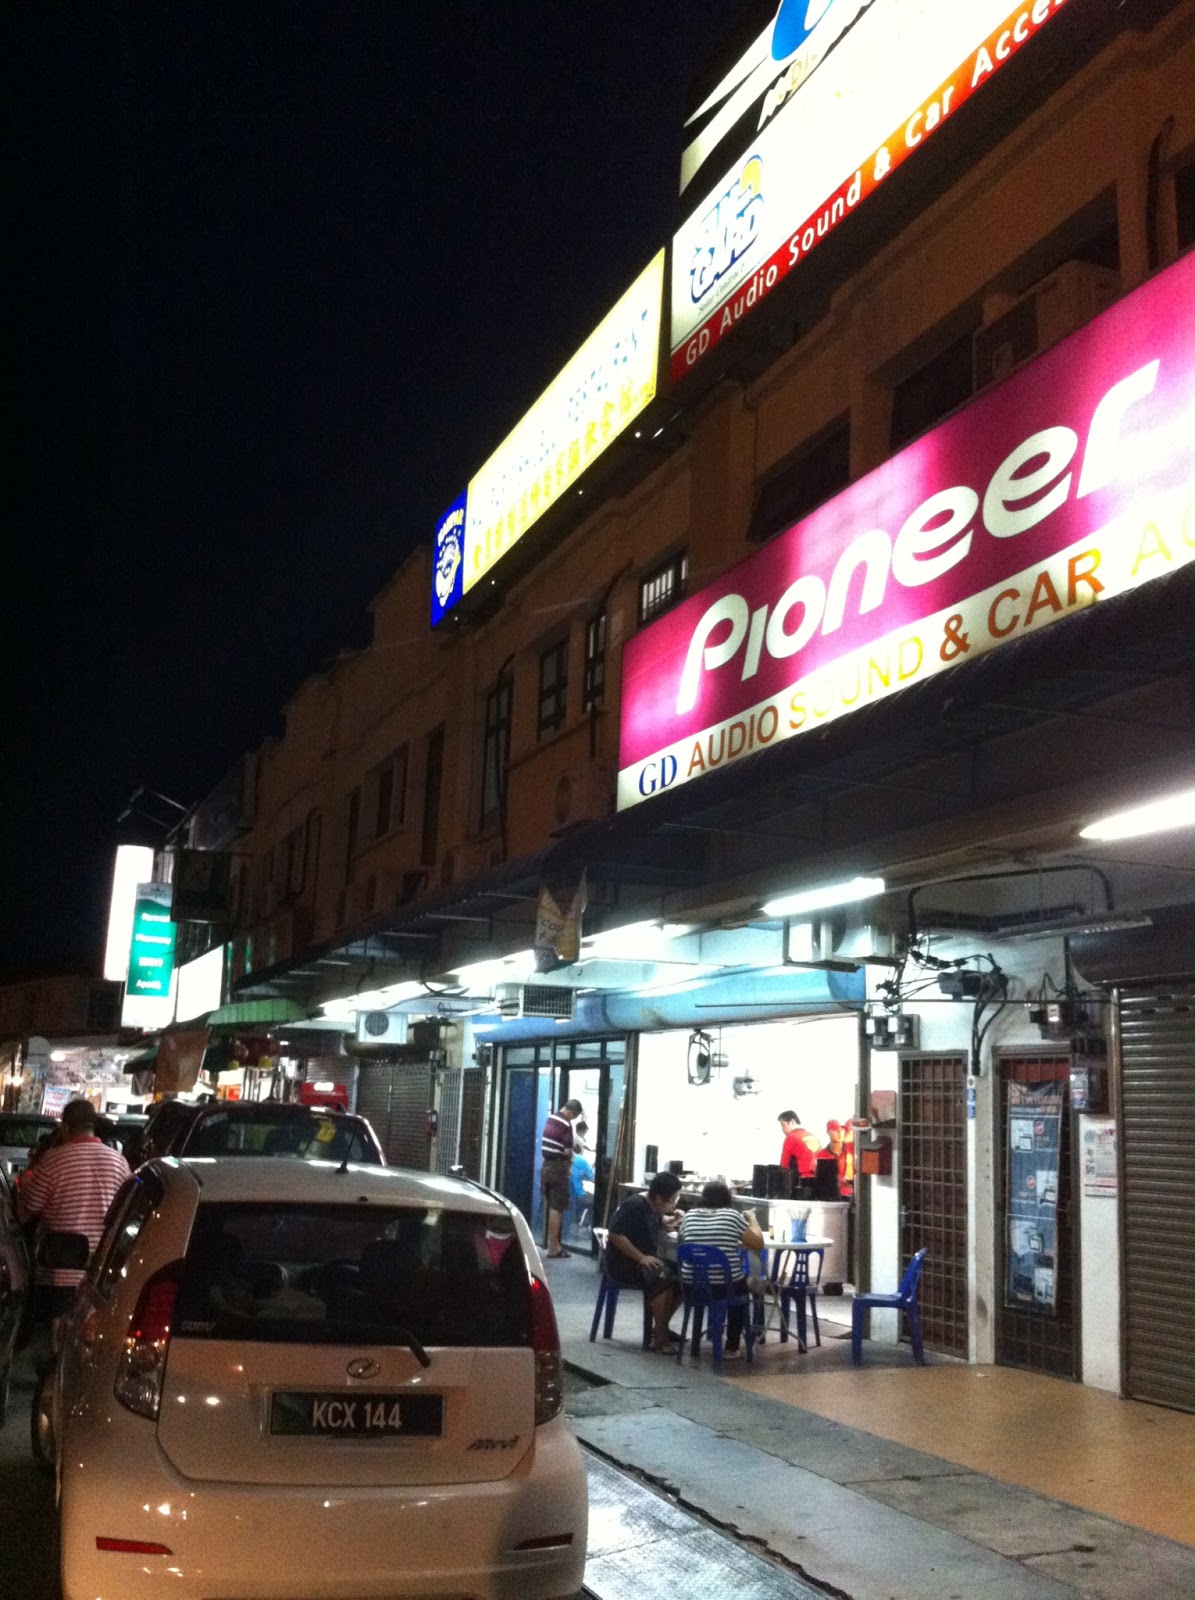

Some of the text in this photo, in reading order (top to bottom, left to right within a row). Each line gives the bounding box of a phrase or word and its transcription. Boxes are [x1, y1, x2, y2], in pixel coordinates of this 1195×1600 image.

[687, 329, 710, 365] GD
[720, 264, 777, 335] Audio
[788, 170, 861, 266] Sound
[873, 146, 891, 181] &
[905, 85, 954, 147] Car
[971, 0, 1063, 88] Acce
[638, 755, 678, 797] GD
[687, 705, 779, 776] AUDIO
[788, 635, 924, 729] SUND
[940, 614, 970, 662] &
[987, 548, 1105, 641] CAR
[676, 359, 1160, 715] Pioneer
[313, 1401, 402, 1428] KCX 144
